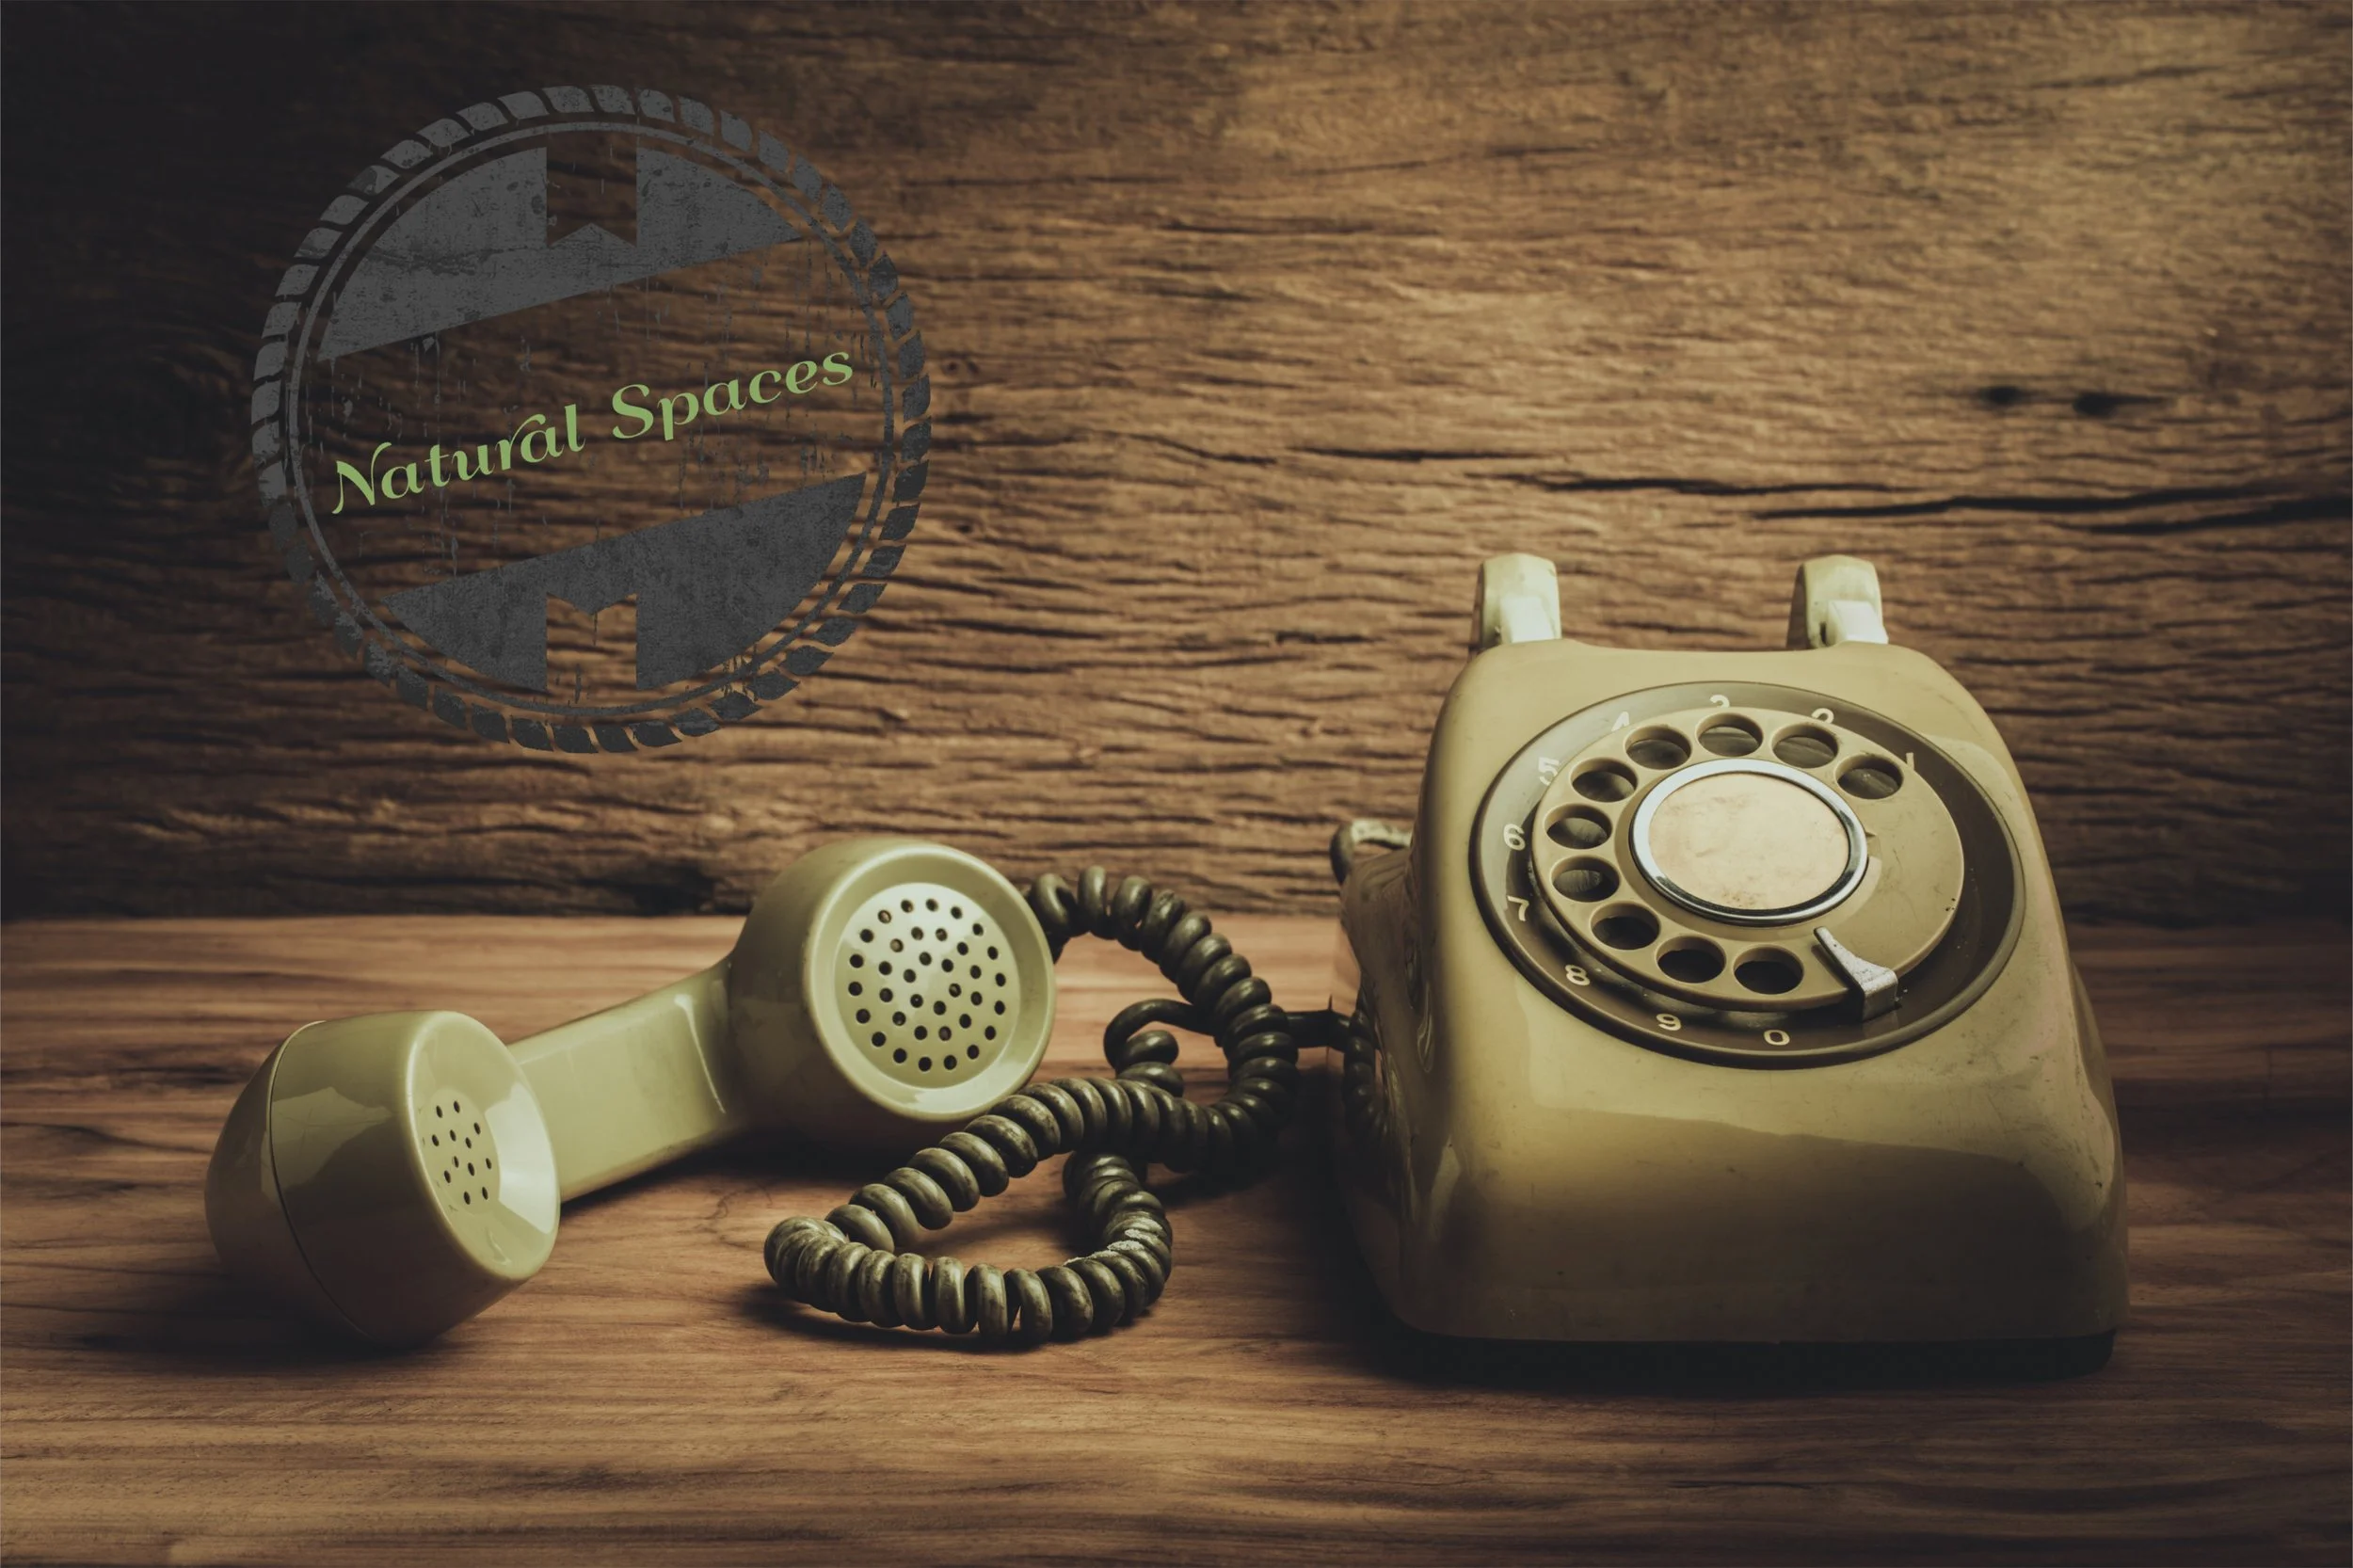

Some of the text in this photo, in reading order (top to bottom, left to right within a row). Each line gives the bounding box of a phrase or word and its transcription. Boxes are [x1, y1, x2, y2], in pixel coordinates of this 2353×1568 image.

[1538, 757, 1560, 786] 5
[1503, 824, 1526, 851] 6
[1507, 895, 1529, 921] 7
[1564, 964, 1591, 986] 8
[1656, 1013, 1682, 1031] 9
[1763, 1029, 1791, 1046] 0
